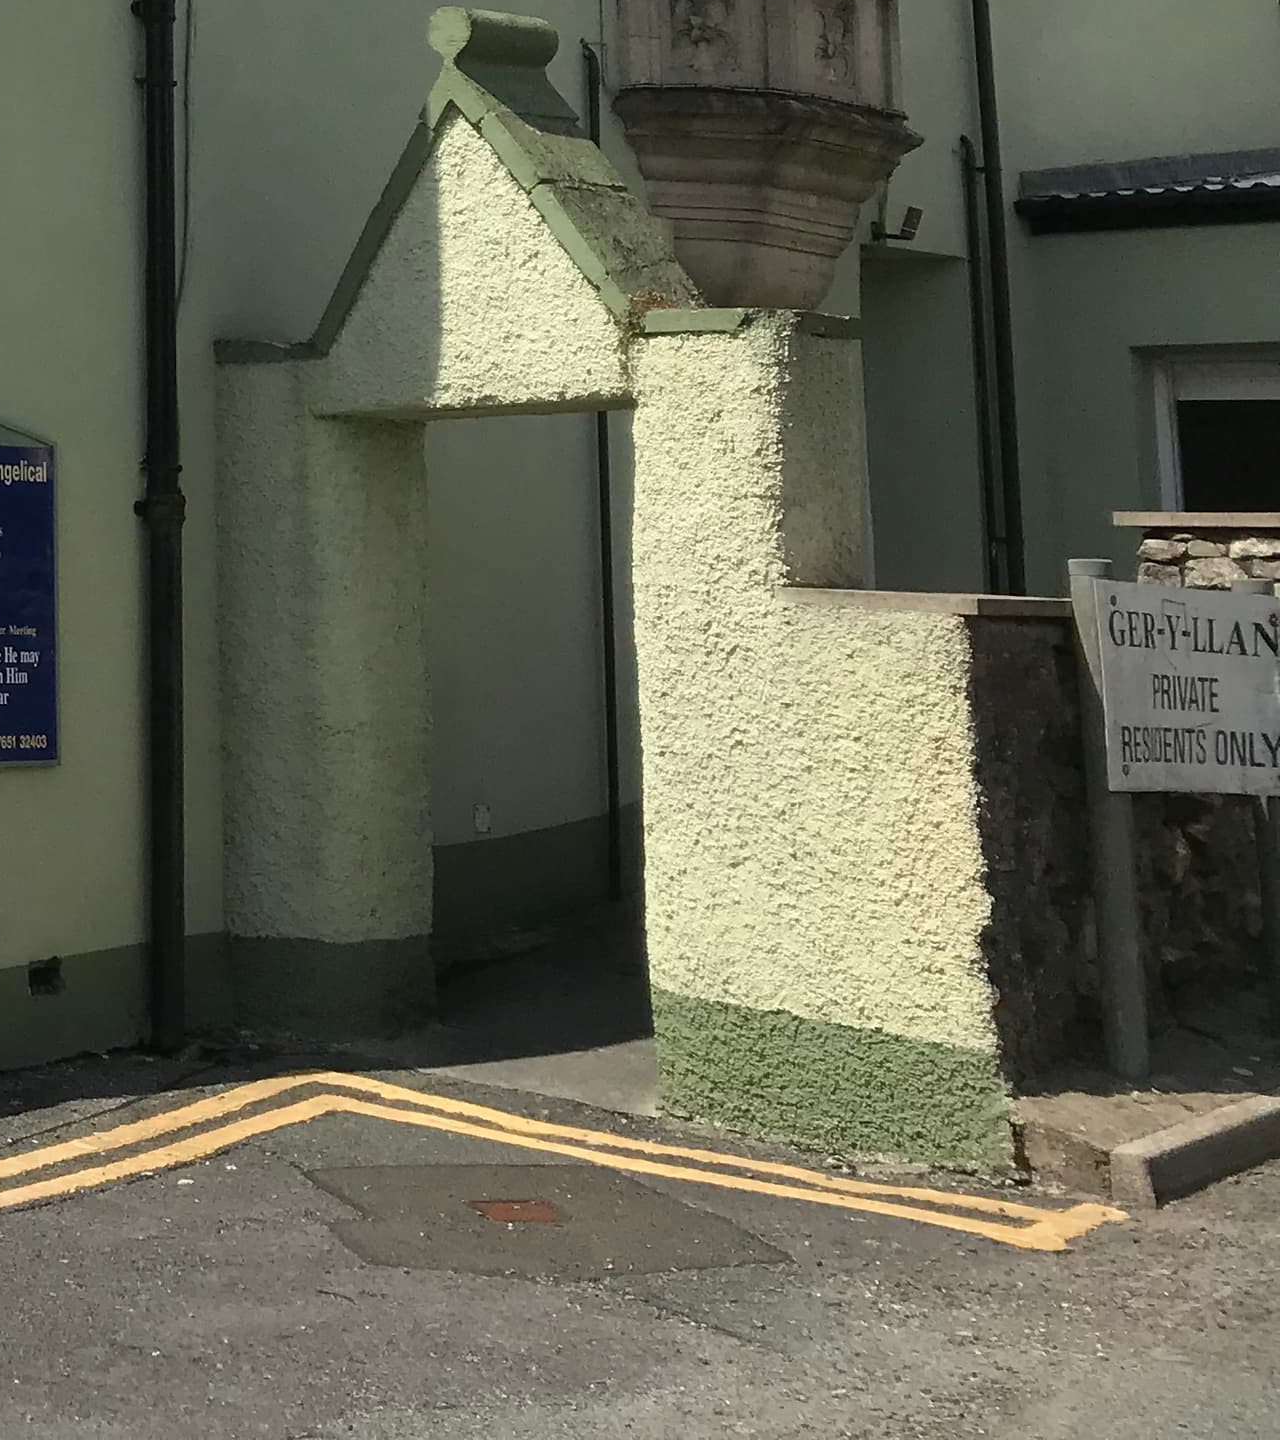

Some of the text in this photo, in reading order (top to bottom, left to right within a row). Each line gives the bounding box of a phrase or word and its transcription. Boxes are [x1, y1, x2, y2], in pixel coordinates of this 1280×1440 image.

[9, 624, 37, 637] Meeting
[1109, 610, 1280, 657] GER-Y-LLAN
[4, 647, 18, 663] He
[20, 651, 40, 667] may
[6, 667, 28, 684] Him
[1152, 673, 1220, 713] PRIVATE
[20, 735, 47, 749] 32403
[1121, 726, 1280, 768] RESIDENTS ONLY
